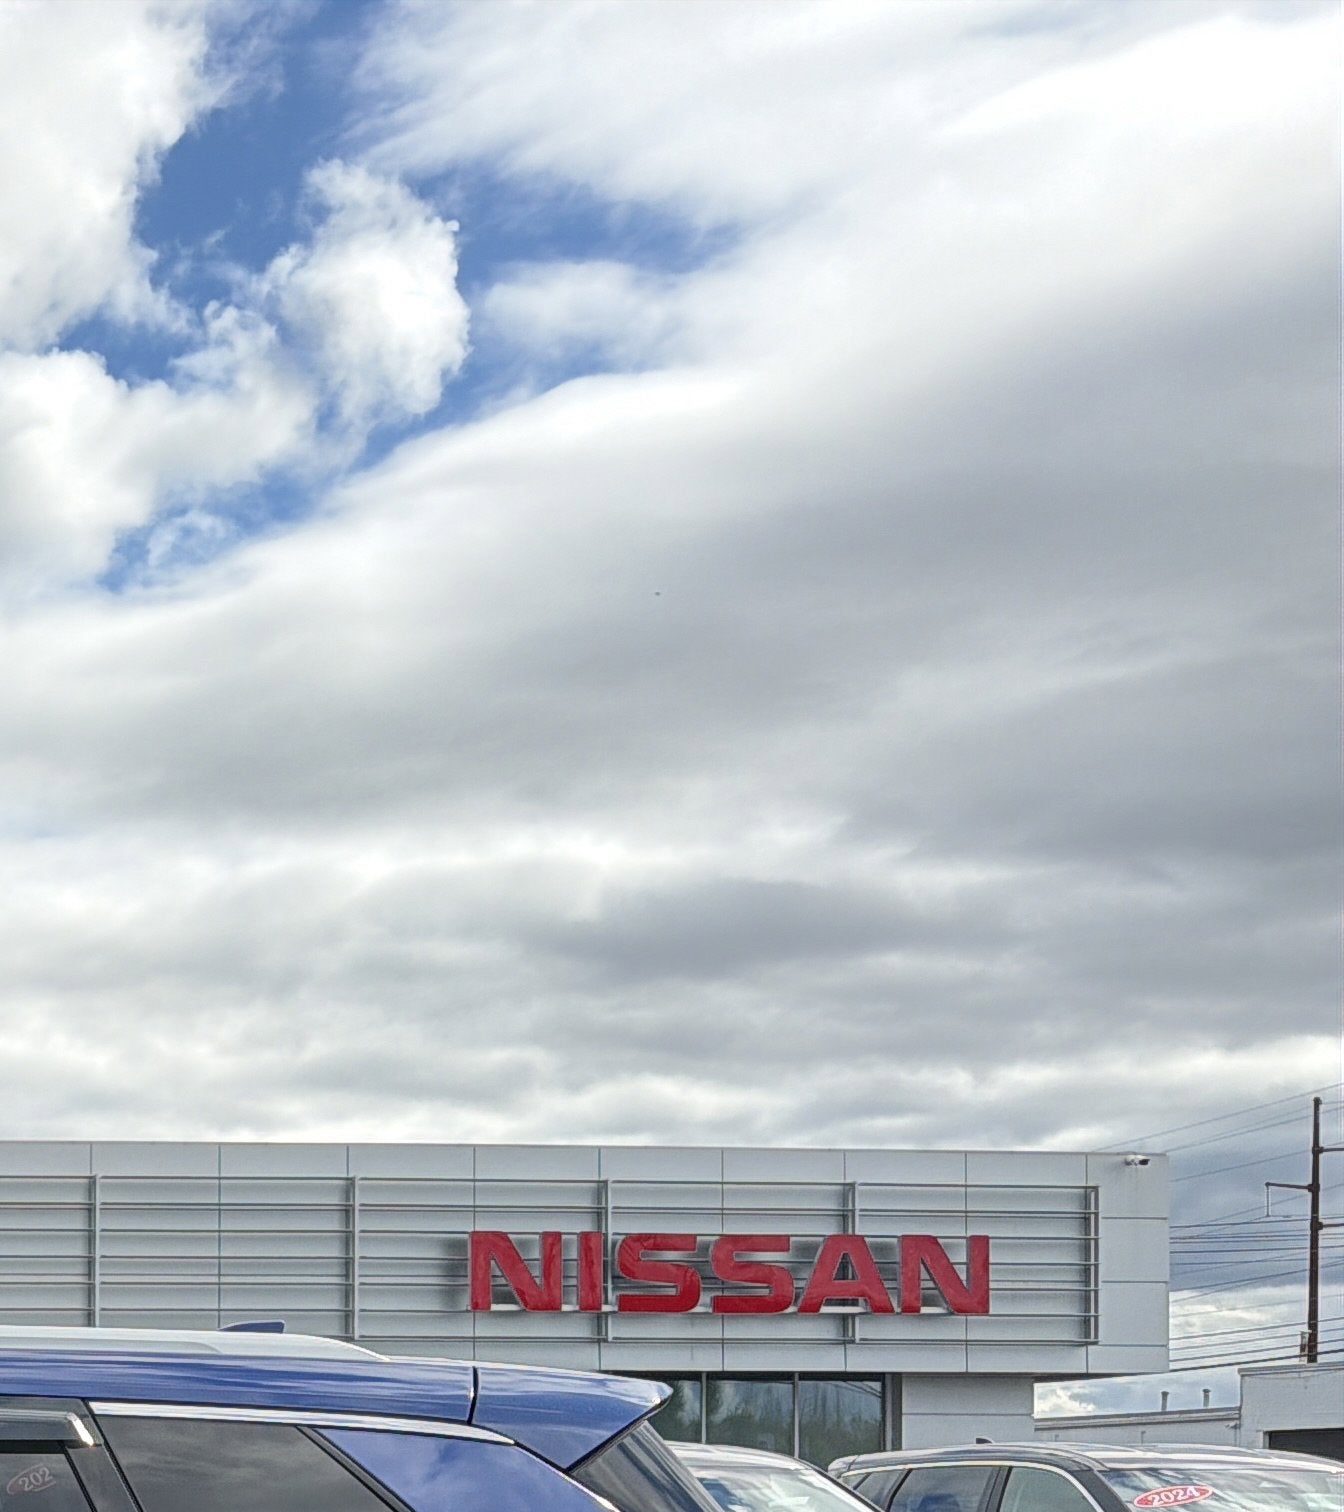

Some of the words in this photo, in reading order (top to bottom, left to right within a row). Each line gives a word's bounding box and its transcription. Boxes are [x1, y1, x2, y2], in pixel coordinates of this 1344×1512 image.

[469, 1231, 990, 1314] NISSAN
[18, 1466, 53, 1492] 202
[1147, 1486, 1201, 1507] 2024
